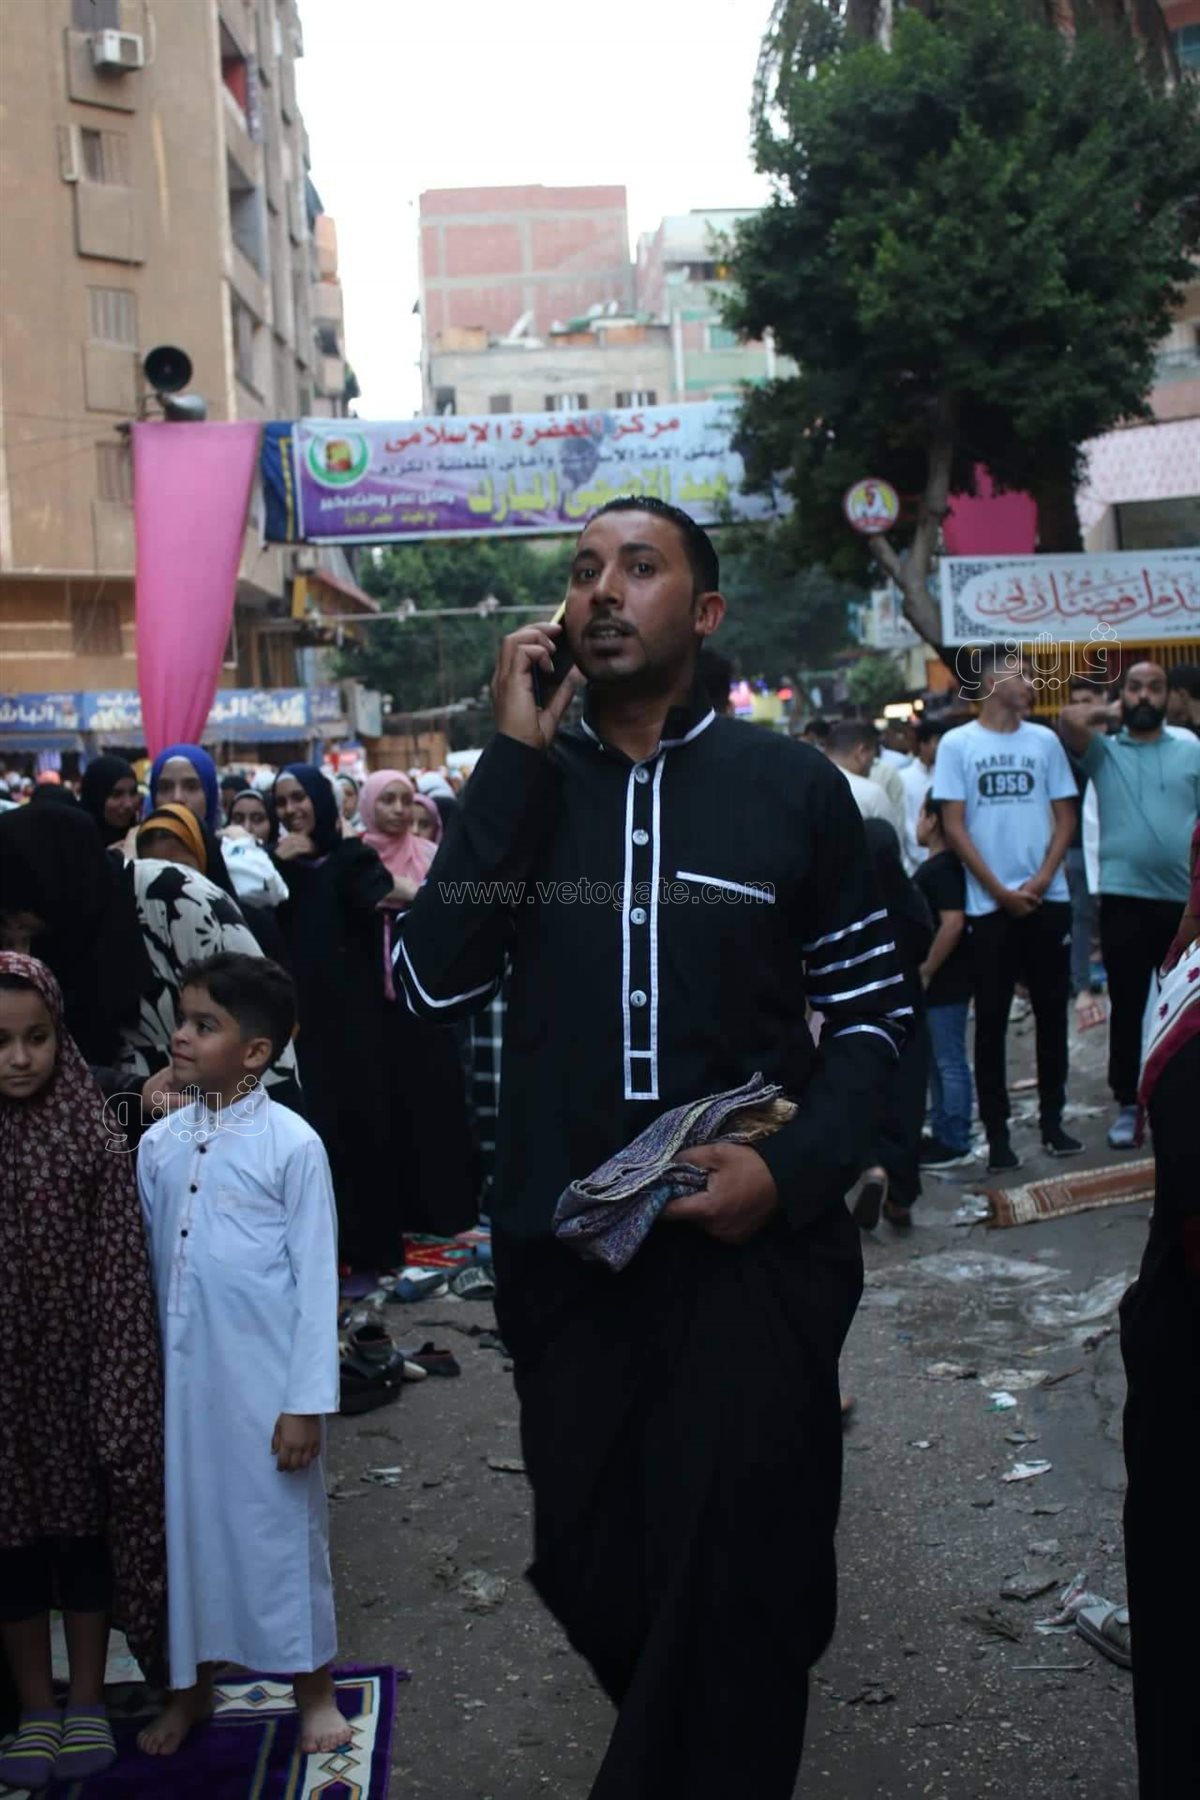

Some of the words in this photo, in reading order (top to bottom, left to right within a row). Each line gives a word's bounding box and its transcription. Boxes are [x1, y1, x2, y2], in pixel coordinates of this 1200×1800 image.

[612, 414, 681, 441] مركز
[975, 753, 1016, 773] MADE
[1021, 755, 1036, 771] IN
[985, 773, 1028, 796] 1958
